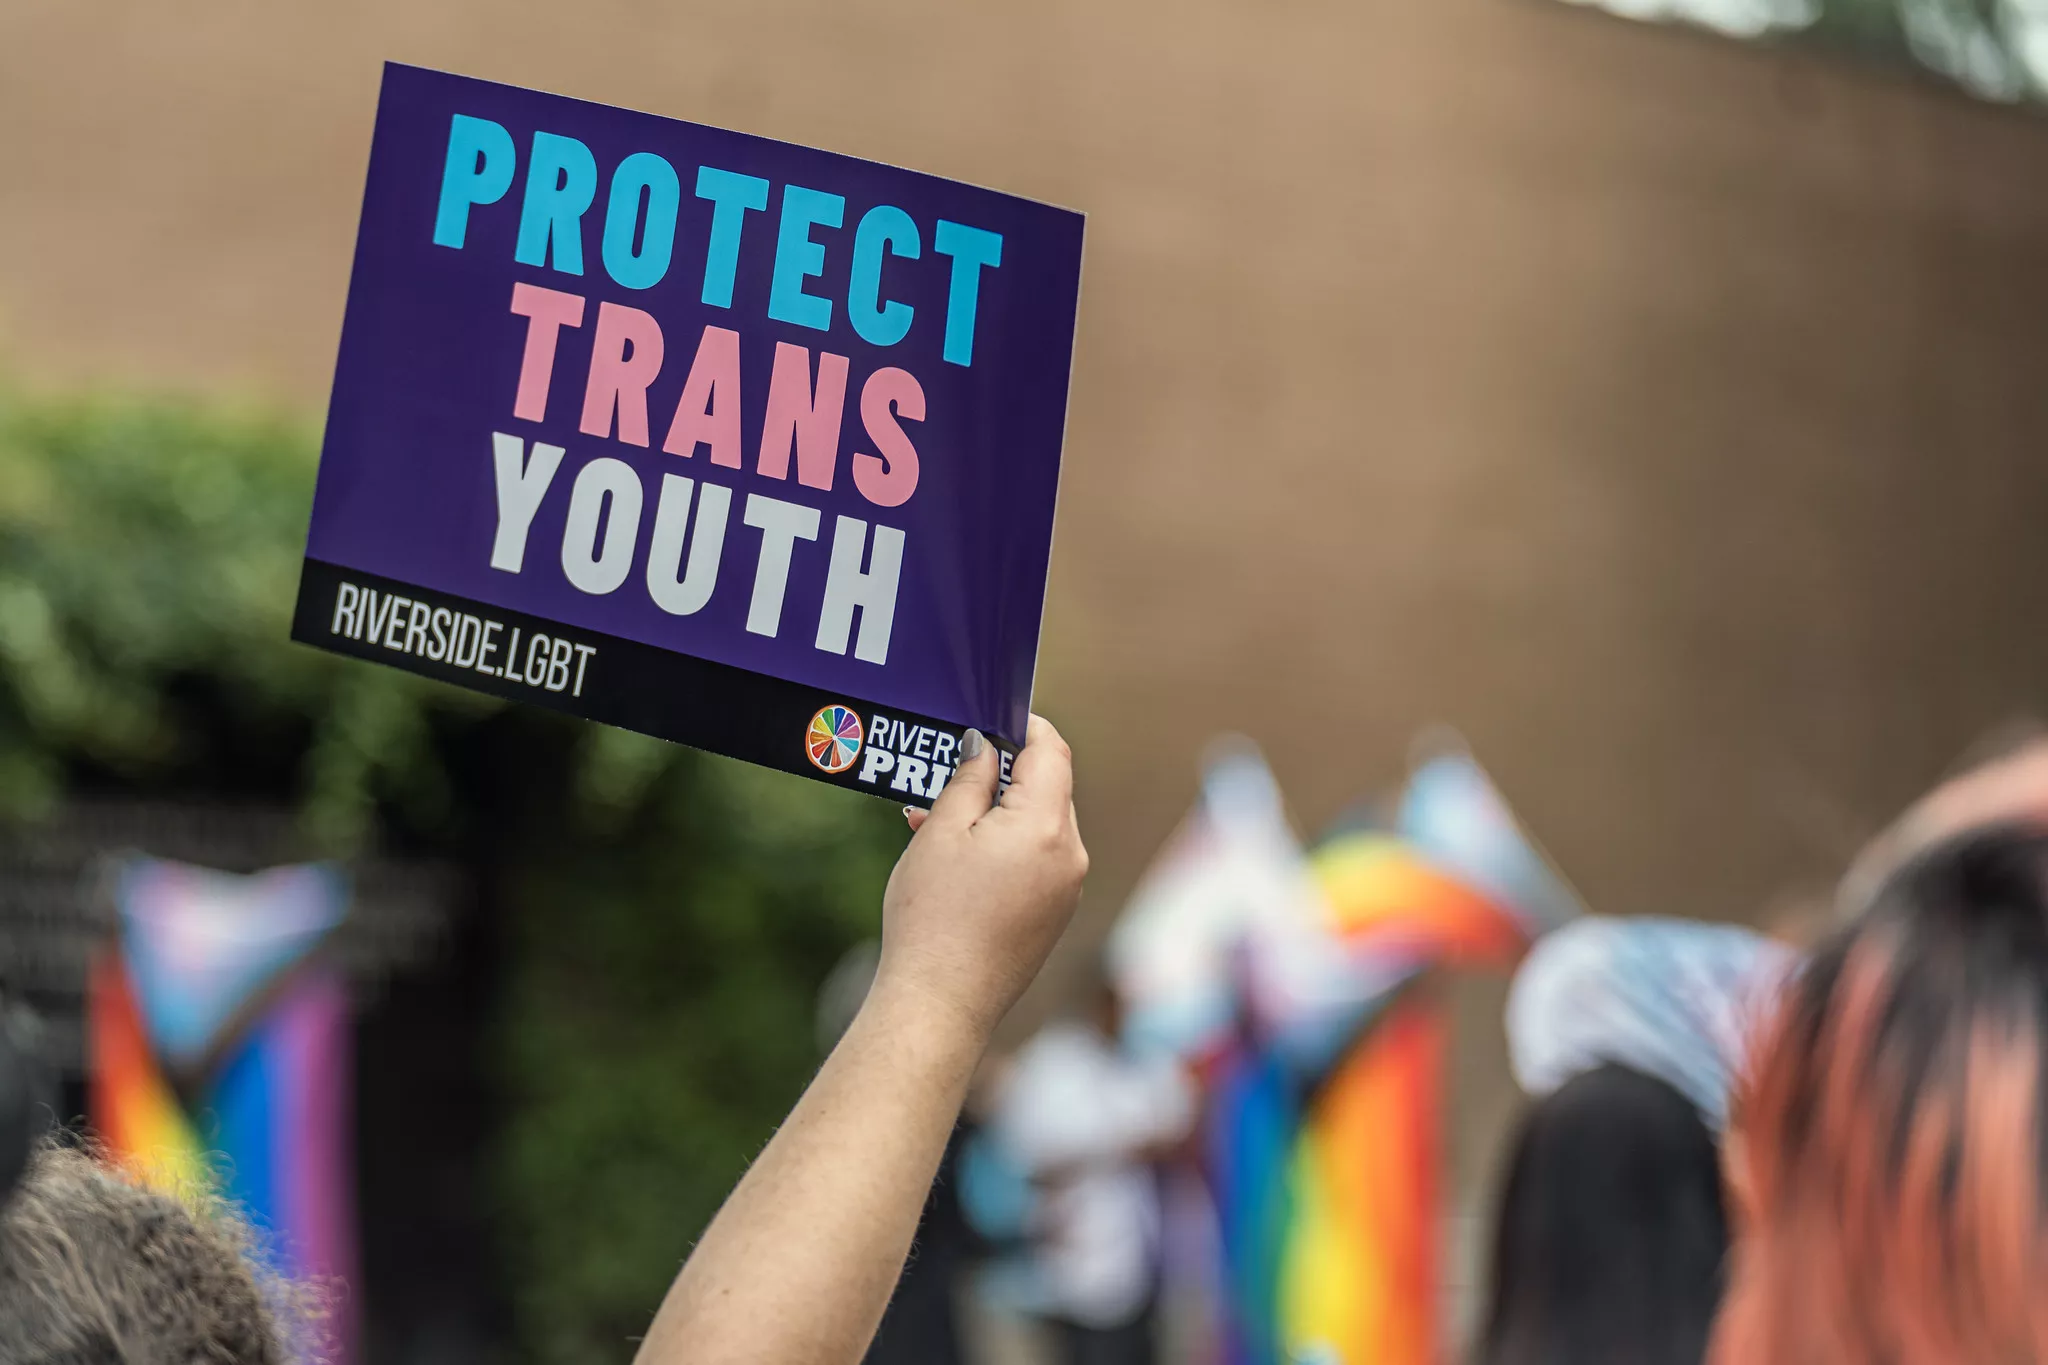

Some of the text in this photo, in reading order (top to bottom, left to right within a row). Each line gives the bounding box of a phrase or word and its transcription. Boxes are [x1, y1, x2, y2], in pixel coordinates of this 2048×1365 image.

[433, 113, 1003, 368] PROTECT
[510, 281, 926, 508] TRANS
[490, 431, 906, 666] YOUTH
[331, 581, 597, 697] RIVERSIDE.LGBT
[858, 745, 1010, 805] PRI
[867, 714, 1013, 783] RIVERE
